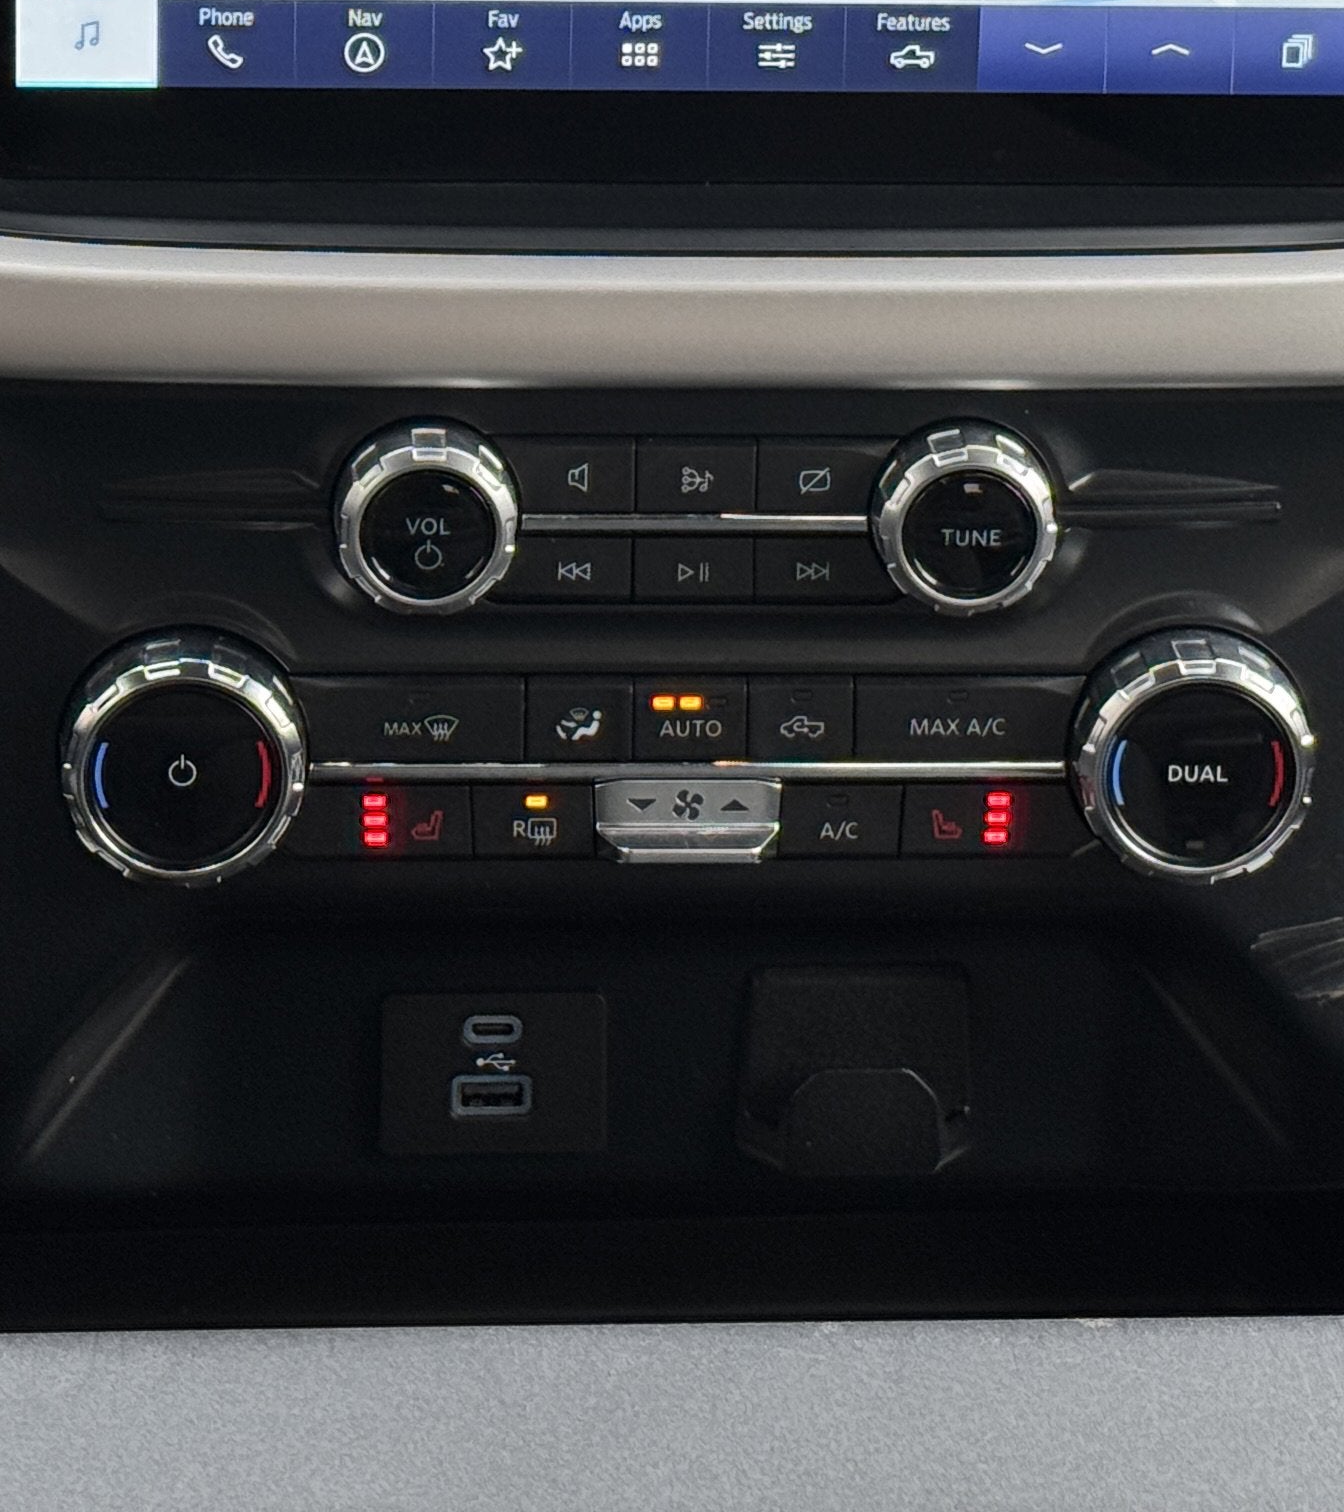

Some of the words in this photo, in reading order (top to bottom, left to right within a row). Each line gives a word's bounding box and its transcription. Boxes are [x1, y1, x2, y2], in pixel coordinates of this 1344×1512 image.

[199, 7, 255, 27] Phone
[348, 8, 383, 27] Nav
[488, 9, 520, 28] Fav
[619, 10, 663, 32] Apps
[742, 11, 813, 34] Settings
[877, 12, 951, 32] Features
[405, 517, 451, 536] VOL
[941, 528, 1001, 547] TUNE
[384, 721, 422, 736] MAX
[659, 719, 722, 738] AUTO
[910, 718, 960, 736] MAX
[966, 717, 1005, 737] A/C
[1167, 764, 1228, 783] DUAL
[820, 821, 858, 841] A/C
